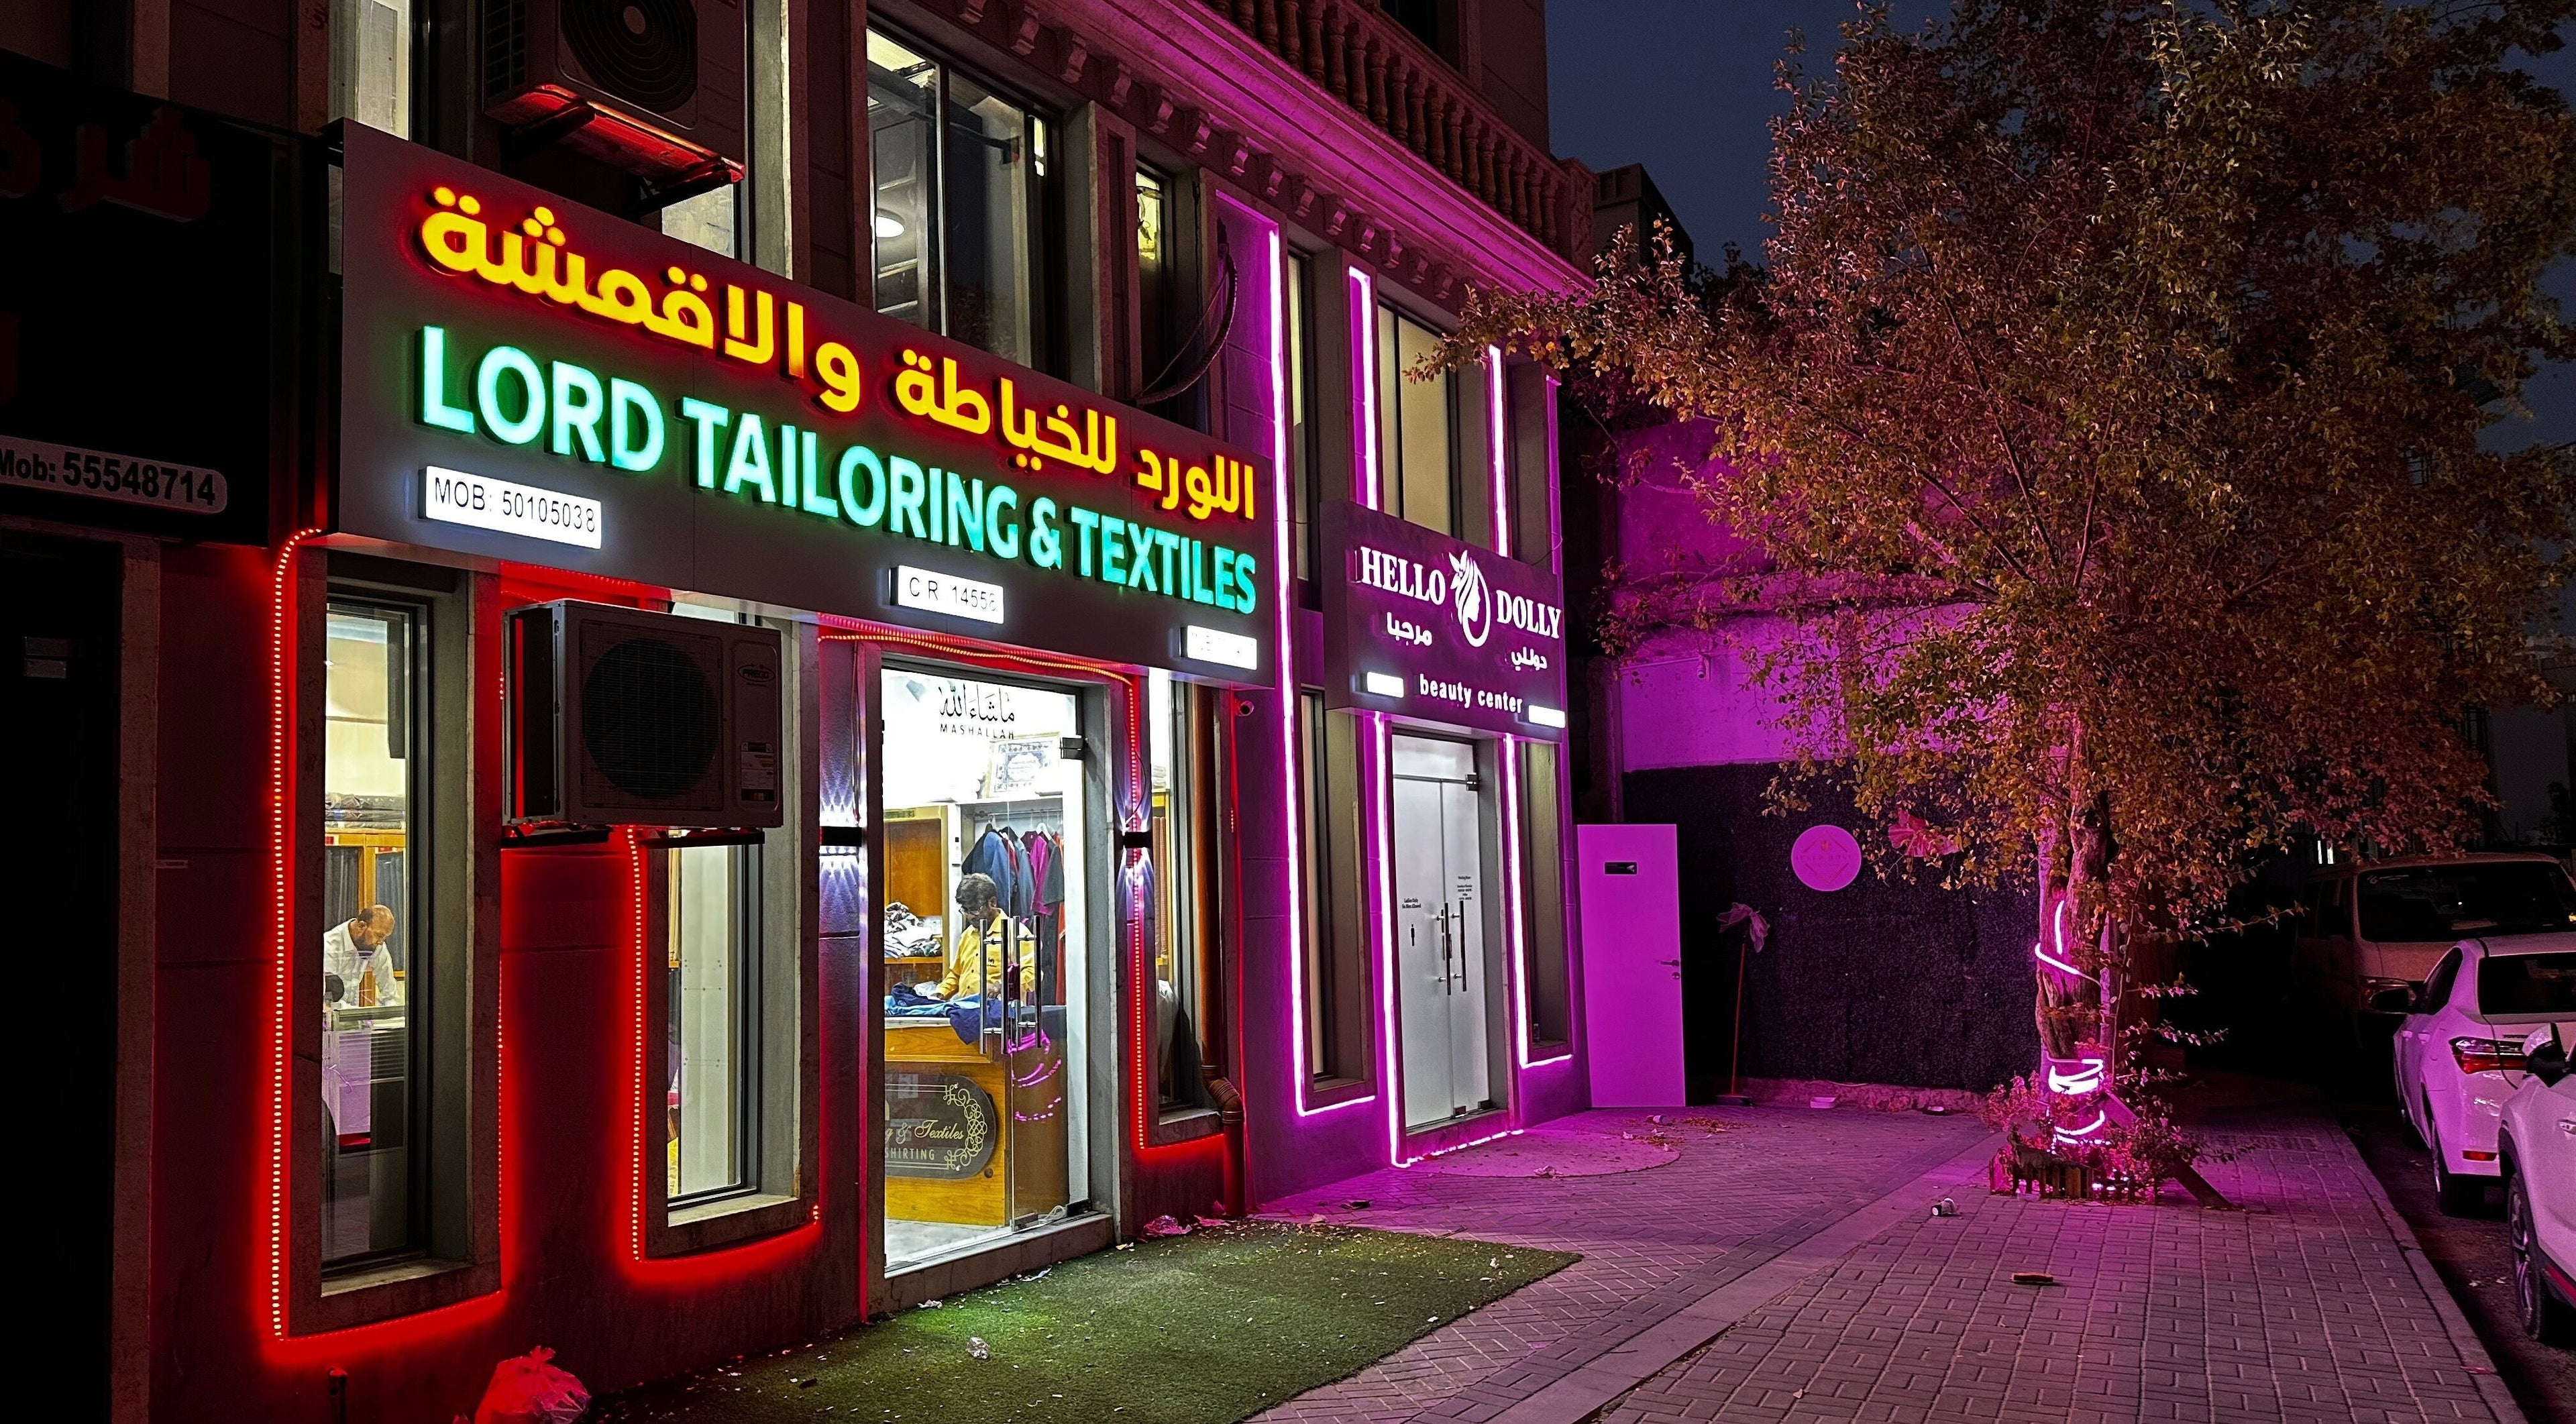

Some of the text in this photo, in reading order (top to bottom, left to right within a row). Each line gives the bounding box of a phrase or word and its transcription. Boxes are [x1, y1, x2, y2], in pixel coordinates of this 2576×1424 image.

[895, 348, 1117, 474] للخياطة
[0, 448, 215, 506] Mob: 55548714
[423, 325, 1256, 615] LORD TAILORING & TEXTILES
[1136, 449, 1254, 521] اللورد
[435, 477, 595, 533] MOB: 50105038
[1360, 546, 1562, 639] HELLO DOLLY
[1419, 673, 1523, 714] beauty center
[940, 723, 1014, 741] MASHALLAH
[914, 1119, 965, 1140] Textiles
